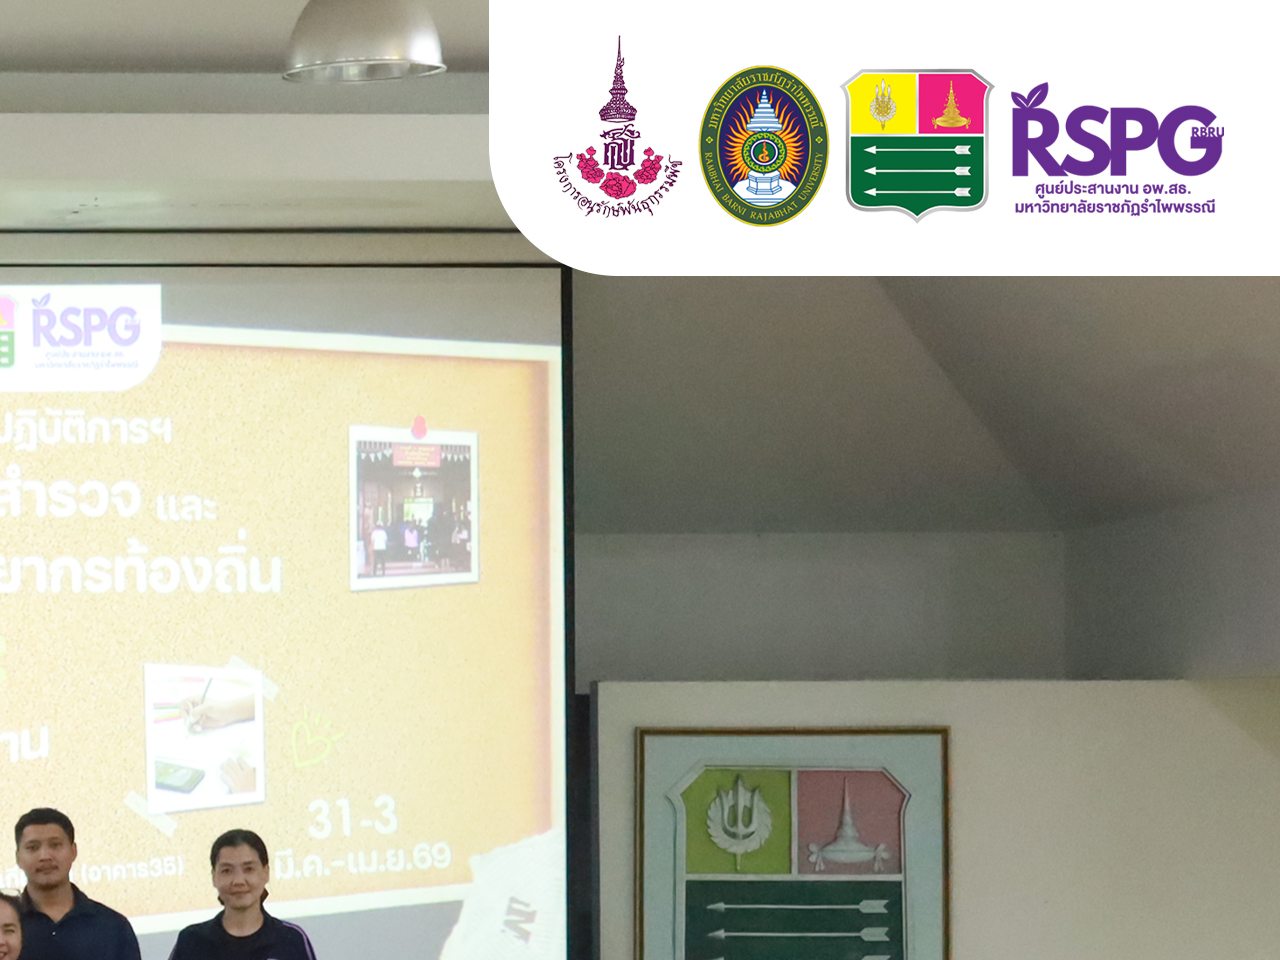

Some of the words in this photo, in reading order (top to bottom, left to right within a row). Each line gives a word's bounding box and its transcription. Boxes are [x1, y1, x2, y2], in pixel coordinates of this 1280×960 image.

[32, 306, 141, 348] RSPG
[156, 493, 217, 521] และ
[274, 842, 452, 880] มี.ค.-เม.ย.69
